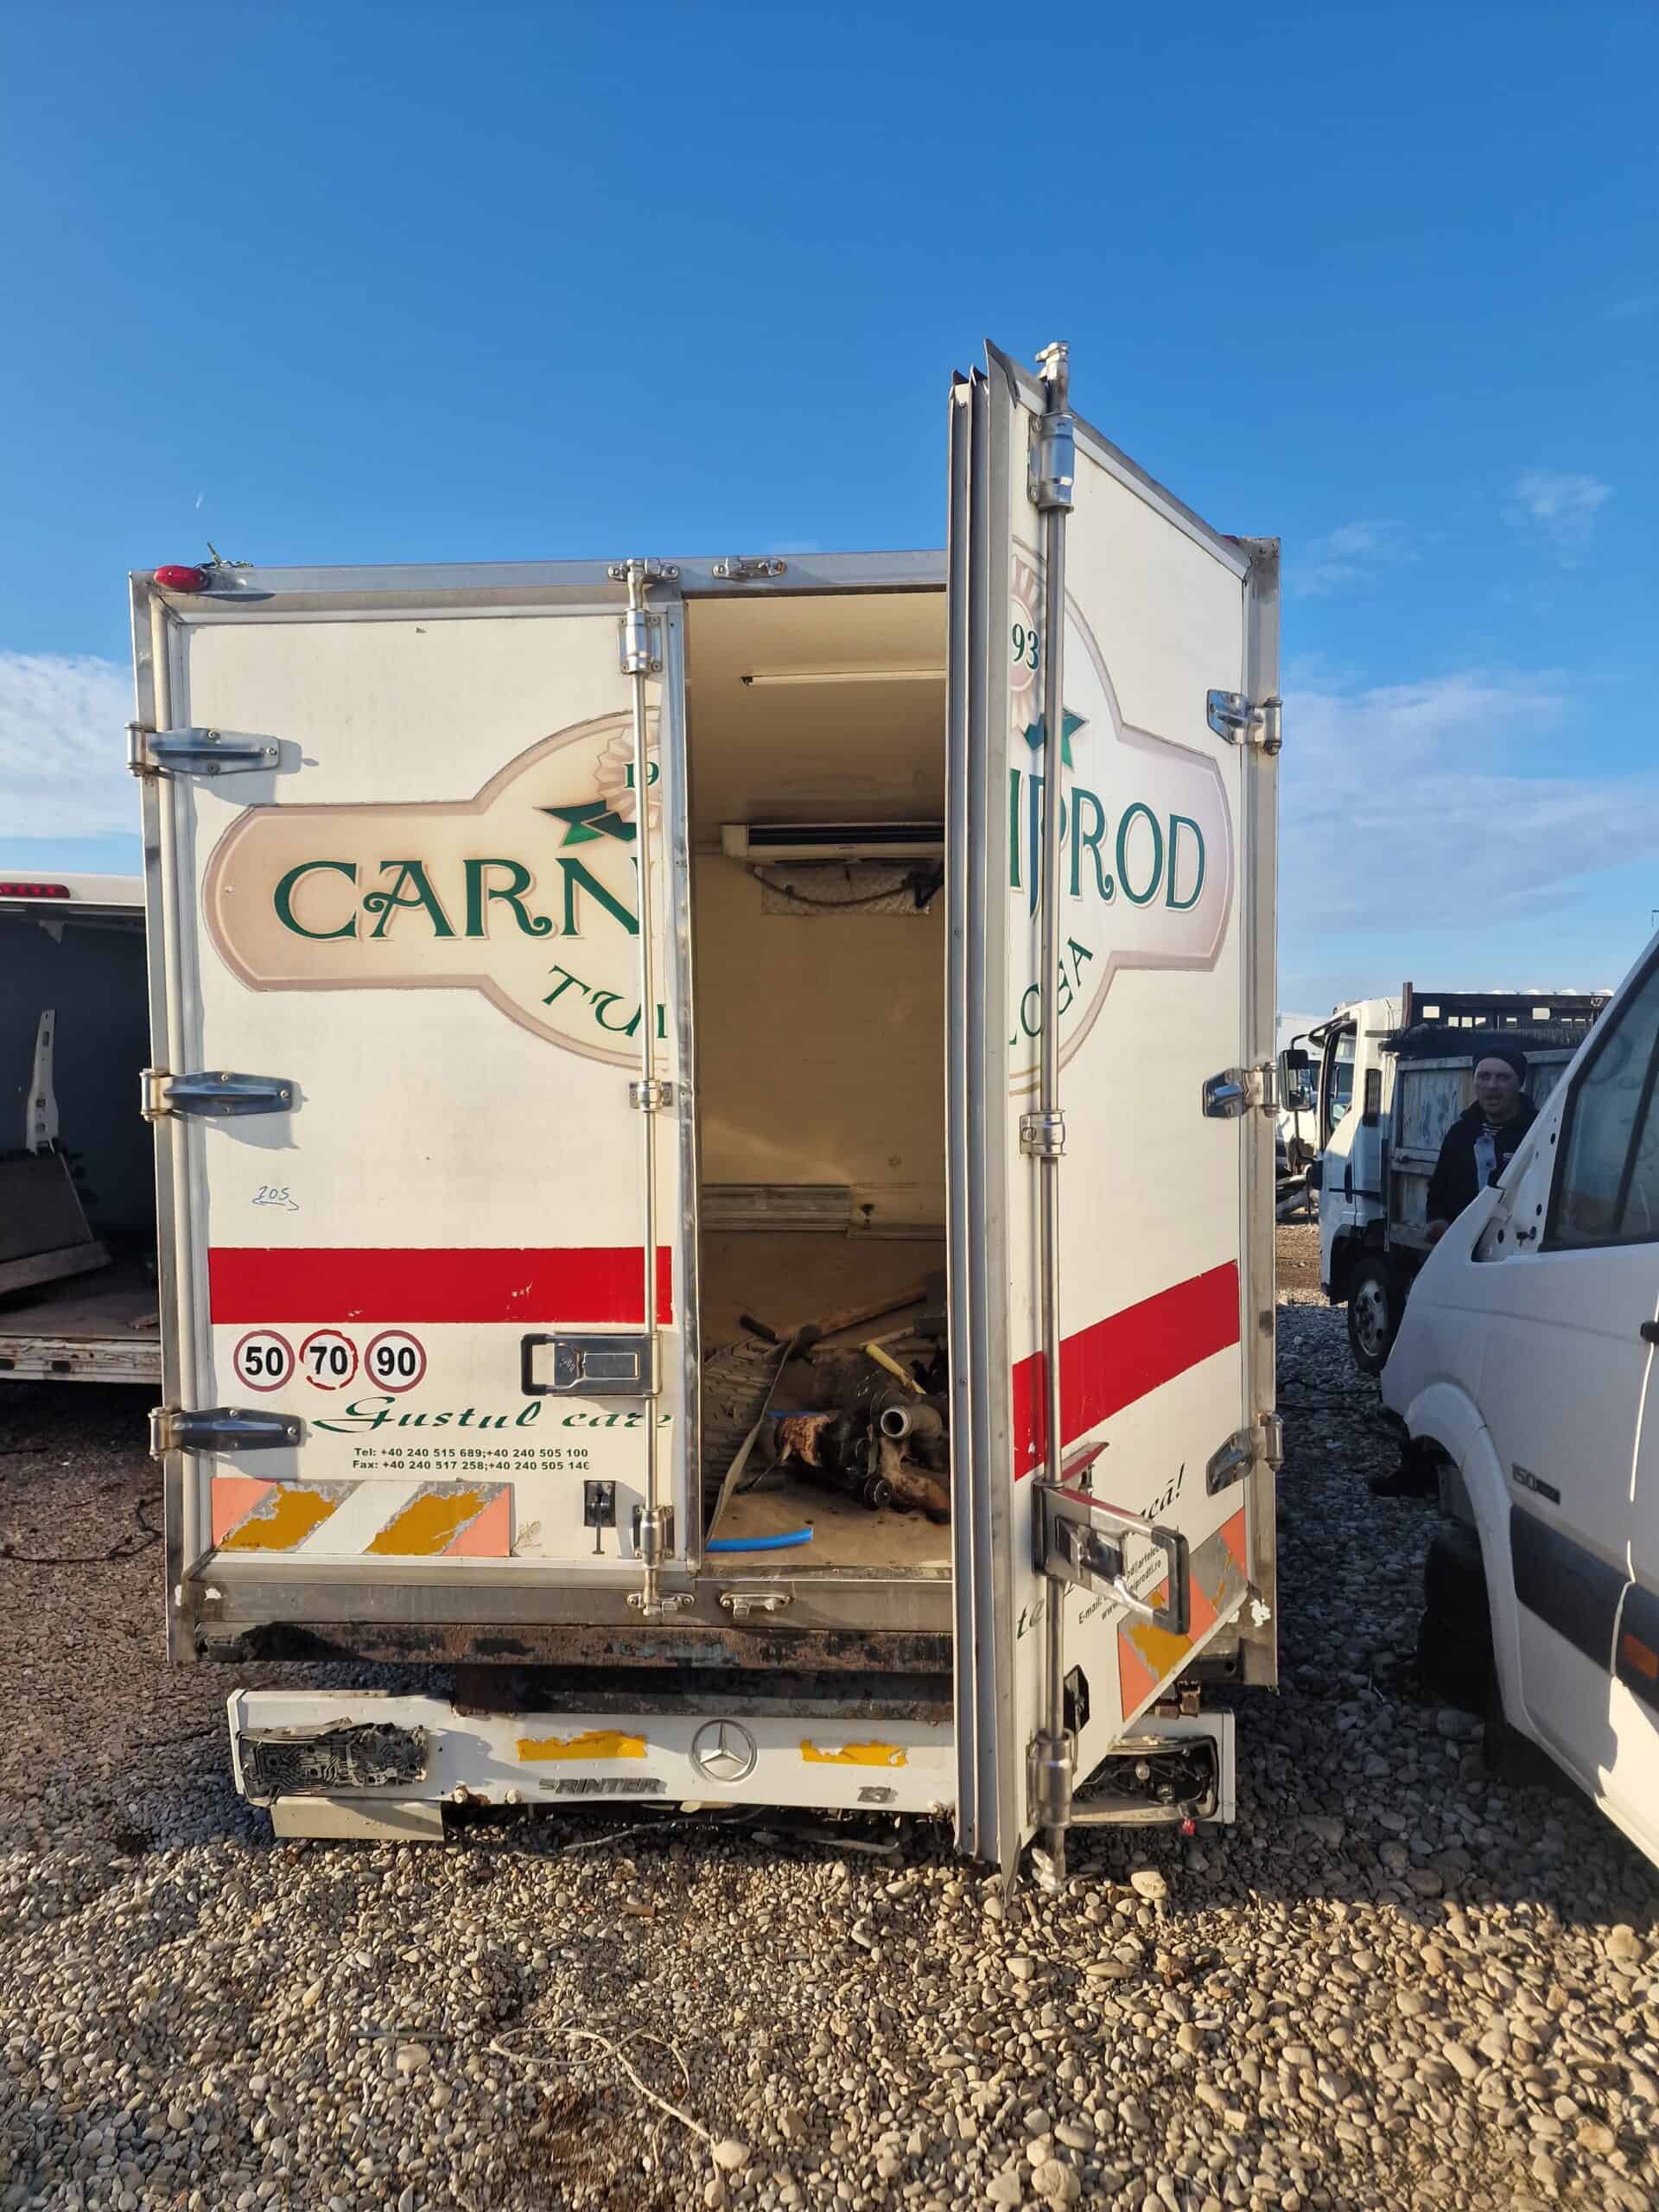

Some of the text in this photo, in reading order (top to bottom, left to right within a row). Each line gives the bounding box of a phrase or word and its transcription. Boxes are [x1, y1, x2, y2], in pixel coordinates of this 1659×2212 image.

[1012, 623, 1039, 670] 93
[623, 761, 659, 789] 19
[274, 856, 640, 939] CARN
[245, 1345, 284, 1376] 50
[309, 1345, 347, 1376] 70
[377, 1346, 416, 1376] 90
[311, 1395, 542, 1433] Gustul
[353, 1446, 377, 1457] Tel:
[381, 1448, 403, 1458] +40
[407, 1448, 429, 1458] 240
[434, 1448, 456, 1459] 515
[512, 1448, 535, 1458] 240
[539, 1448, 562, 1458] 505
[566, 1448, 588, 1458] 100
[353, 1459, 378, 1470] Fax:
[383, 1460, 404, 1470] +40
[409, 1460, 430, 1471] 240
[435, 1460, 457, 1470] 517
[515, 1461, 537, 1471] 240
[541, 1461, 564, 1471] 505
